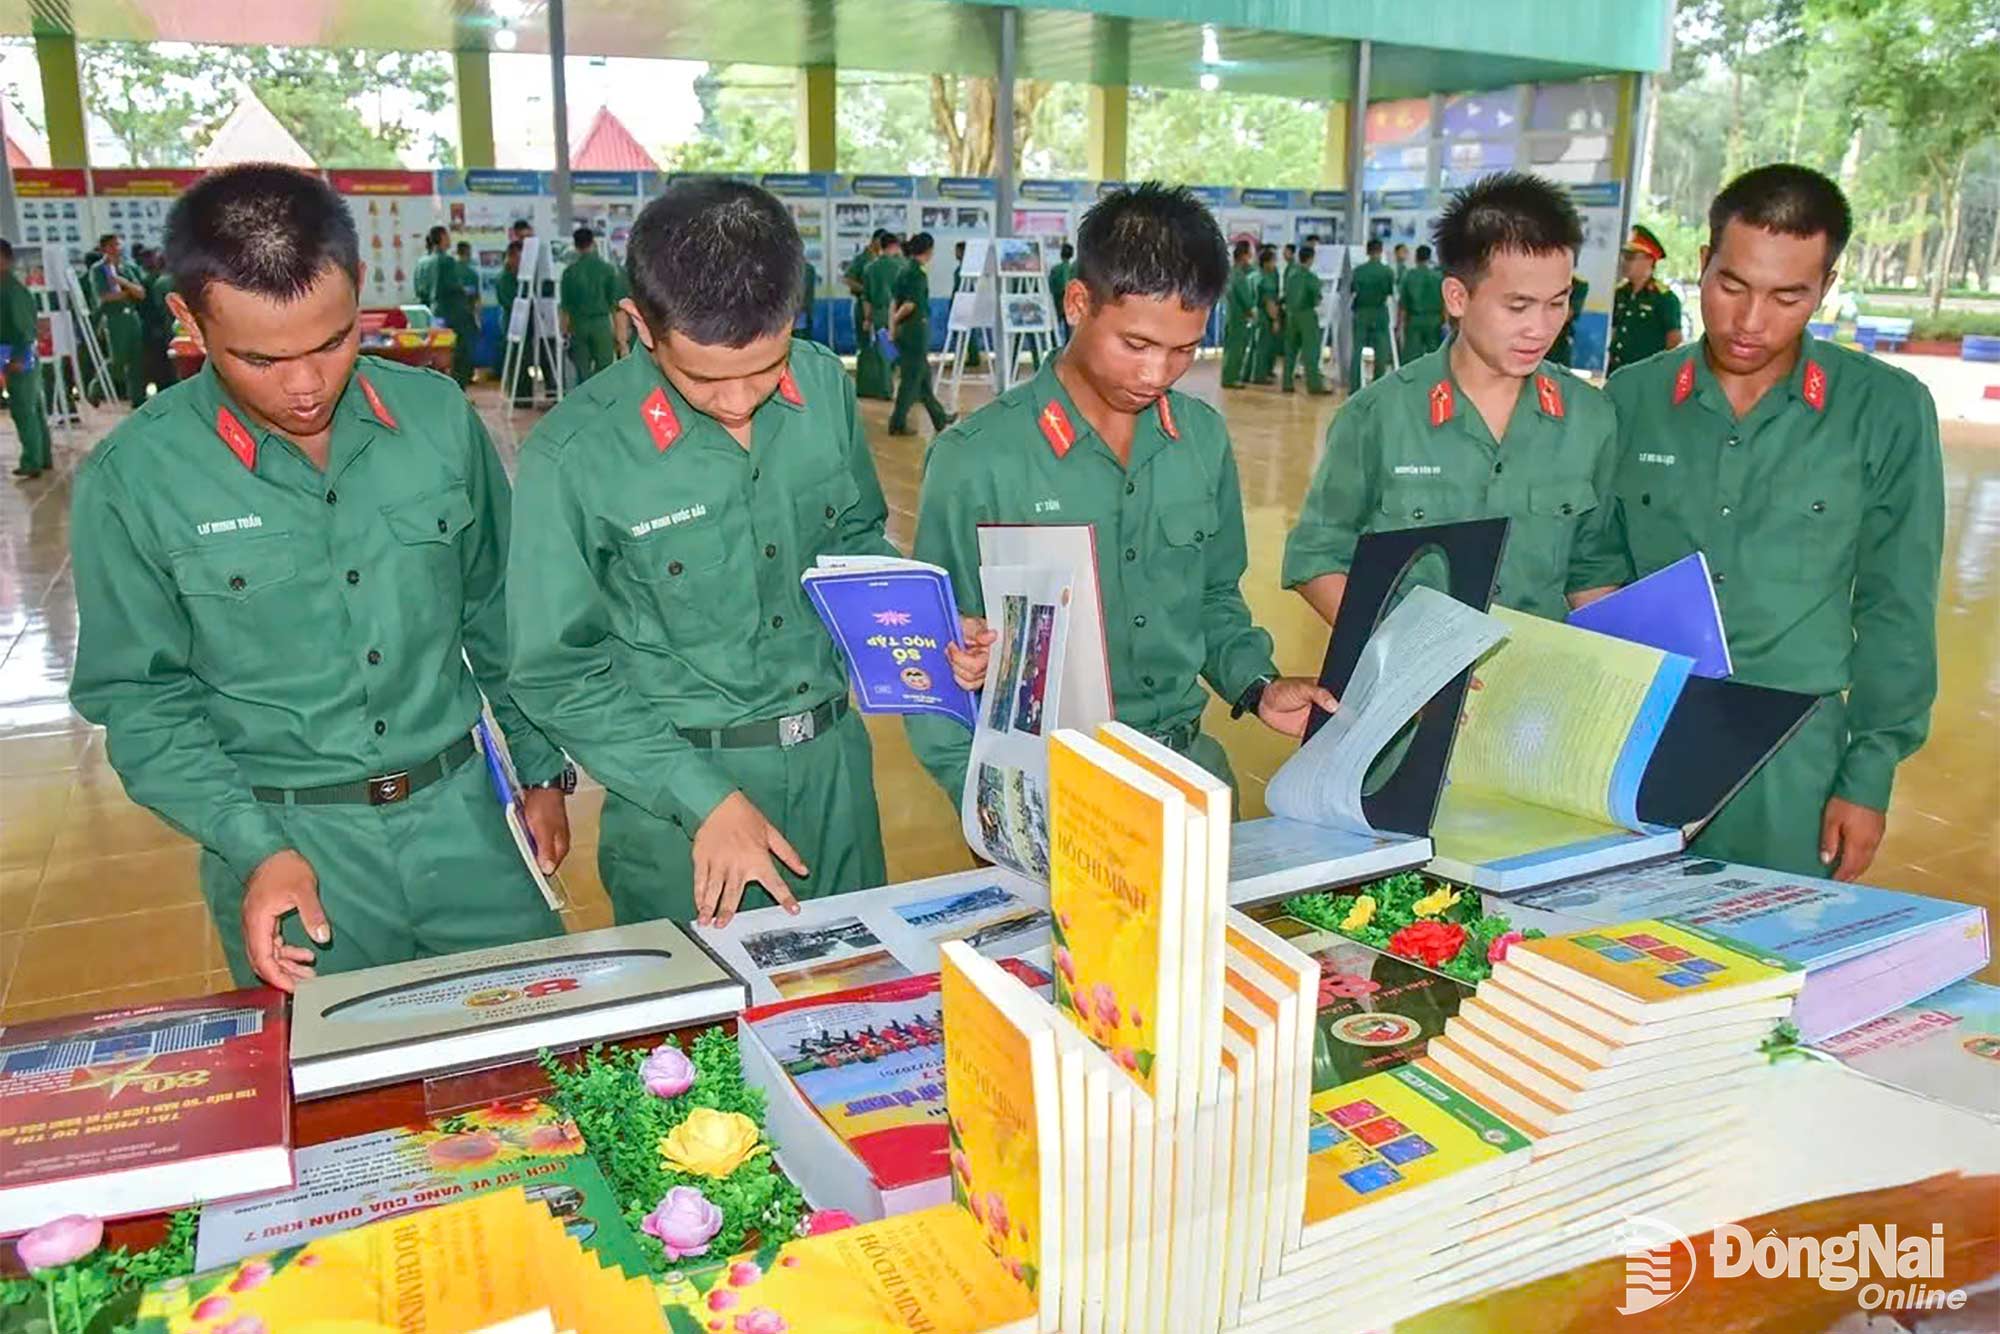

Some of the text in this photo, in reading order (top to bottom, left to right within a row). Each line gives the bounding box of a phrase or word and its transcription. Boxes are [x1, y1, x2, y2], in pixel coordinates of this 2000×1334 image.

[866, 635, 937, 649] HỌC TẬP
[892, 648, 921, 665] SỔ
[413, 1185, 463, 1203] VANG
[369, 1196, 408, 1212] CỦA
[309, 1206, 363, 1227] QUÂN
